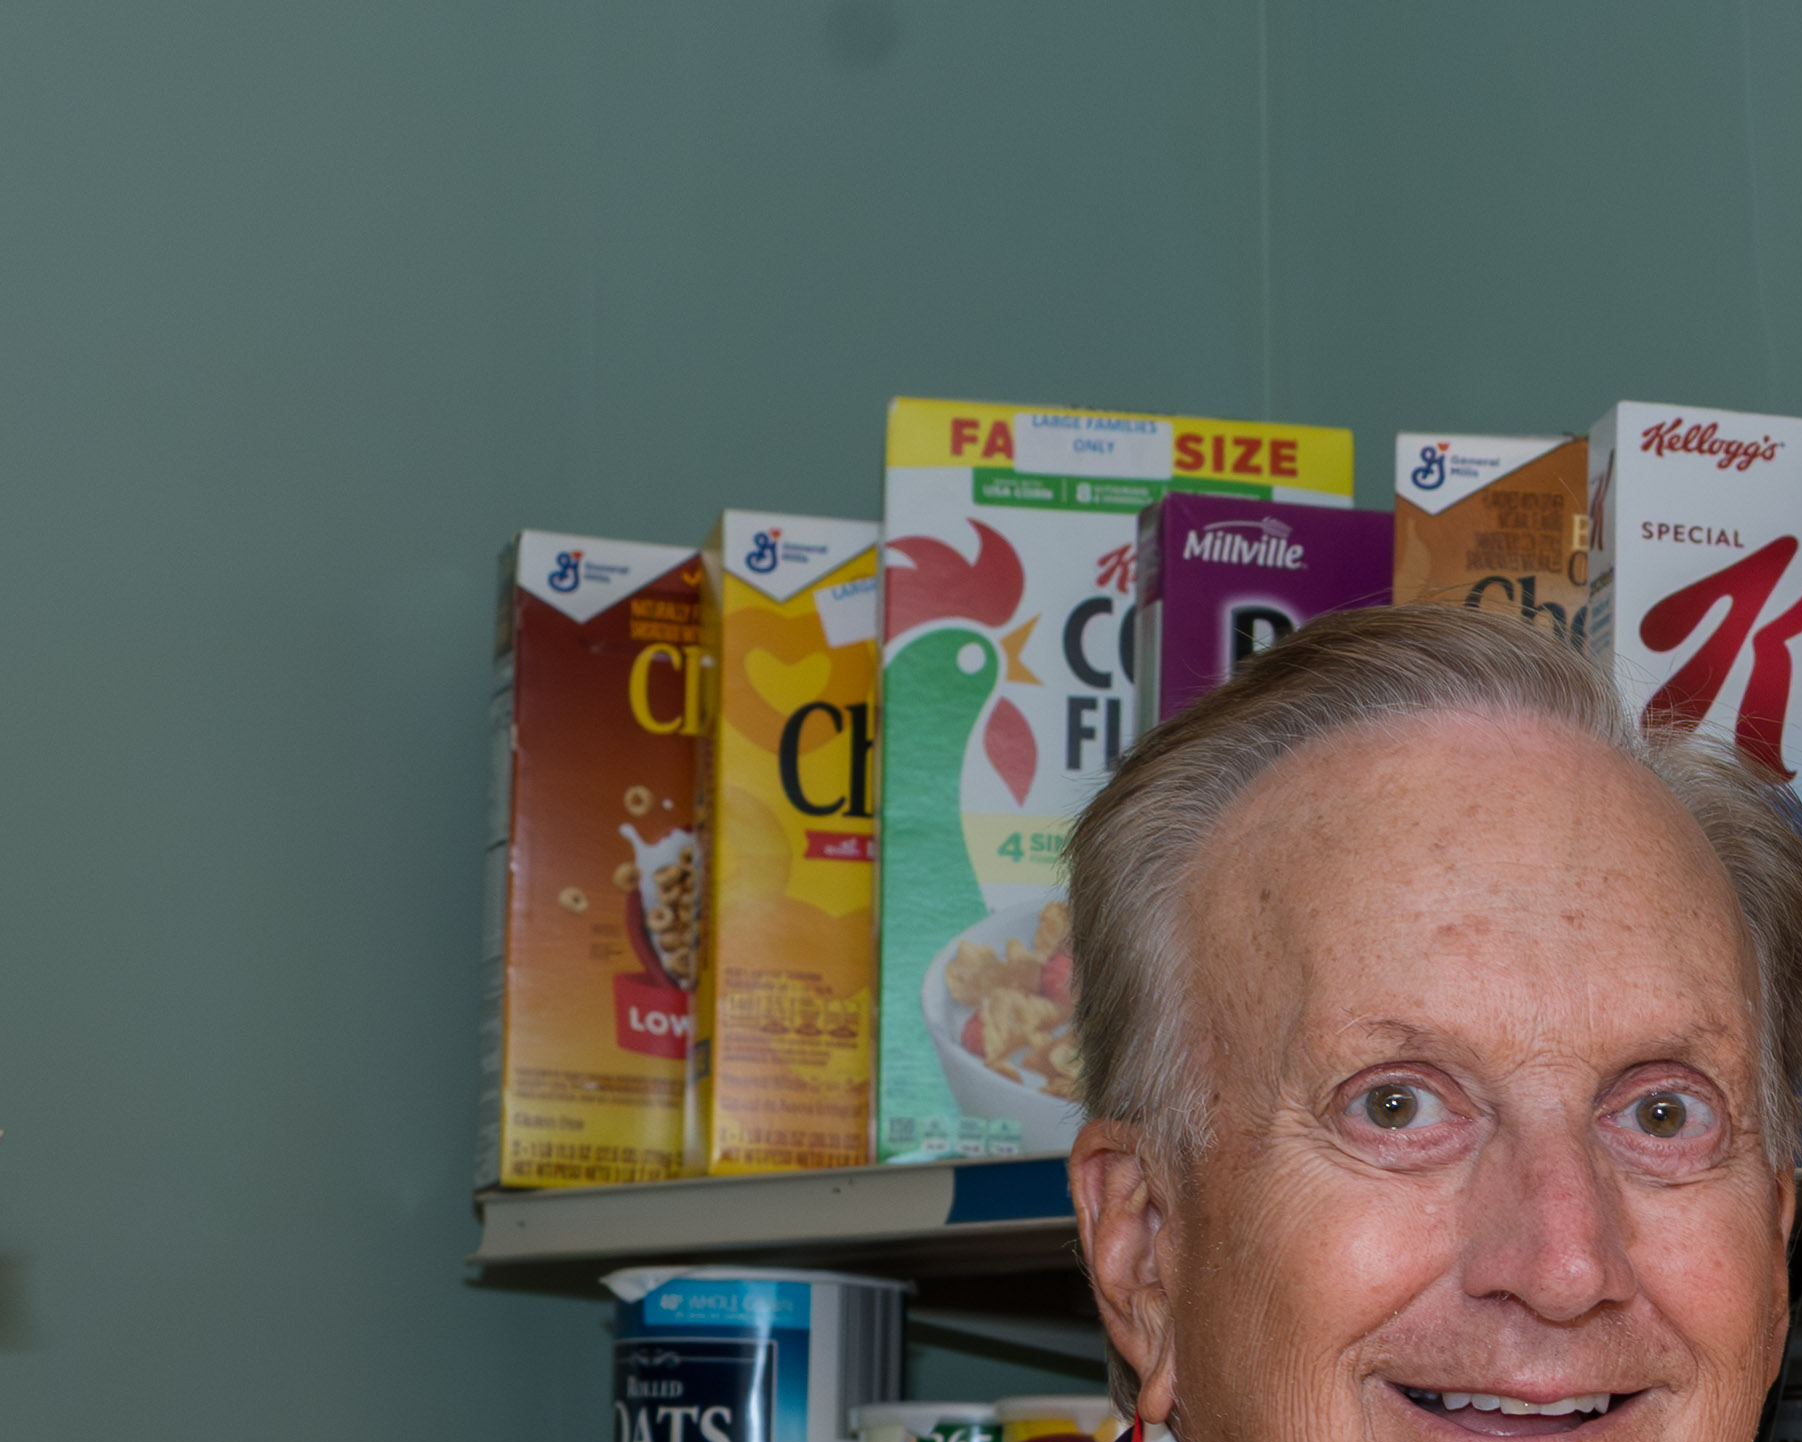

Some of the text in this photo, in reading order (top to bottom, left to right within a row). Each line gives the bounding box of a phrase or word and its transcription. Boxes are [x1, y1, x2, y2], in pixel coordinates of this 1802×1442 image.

[1032, 413, 1080, 430] LARGE
[1173, 432, 1299, 478] SIZE
[1641, 417, 1779, 472] Kellogg's
[1183, 530, 1305, 570] Millville
[1641, 520, 1745, 548] SPECIAL
